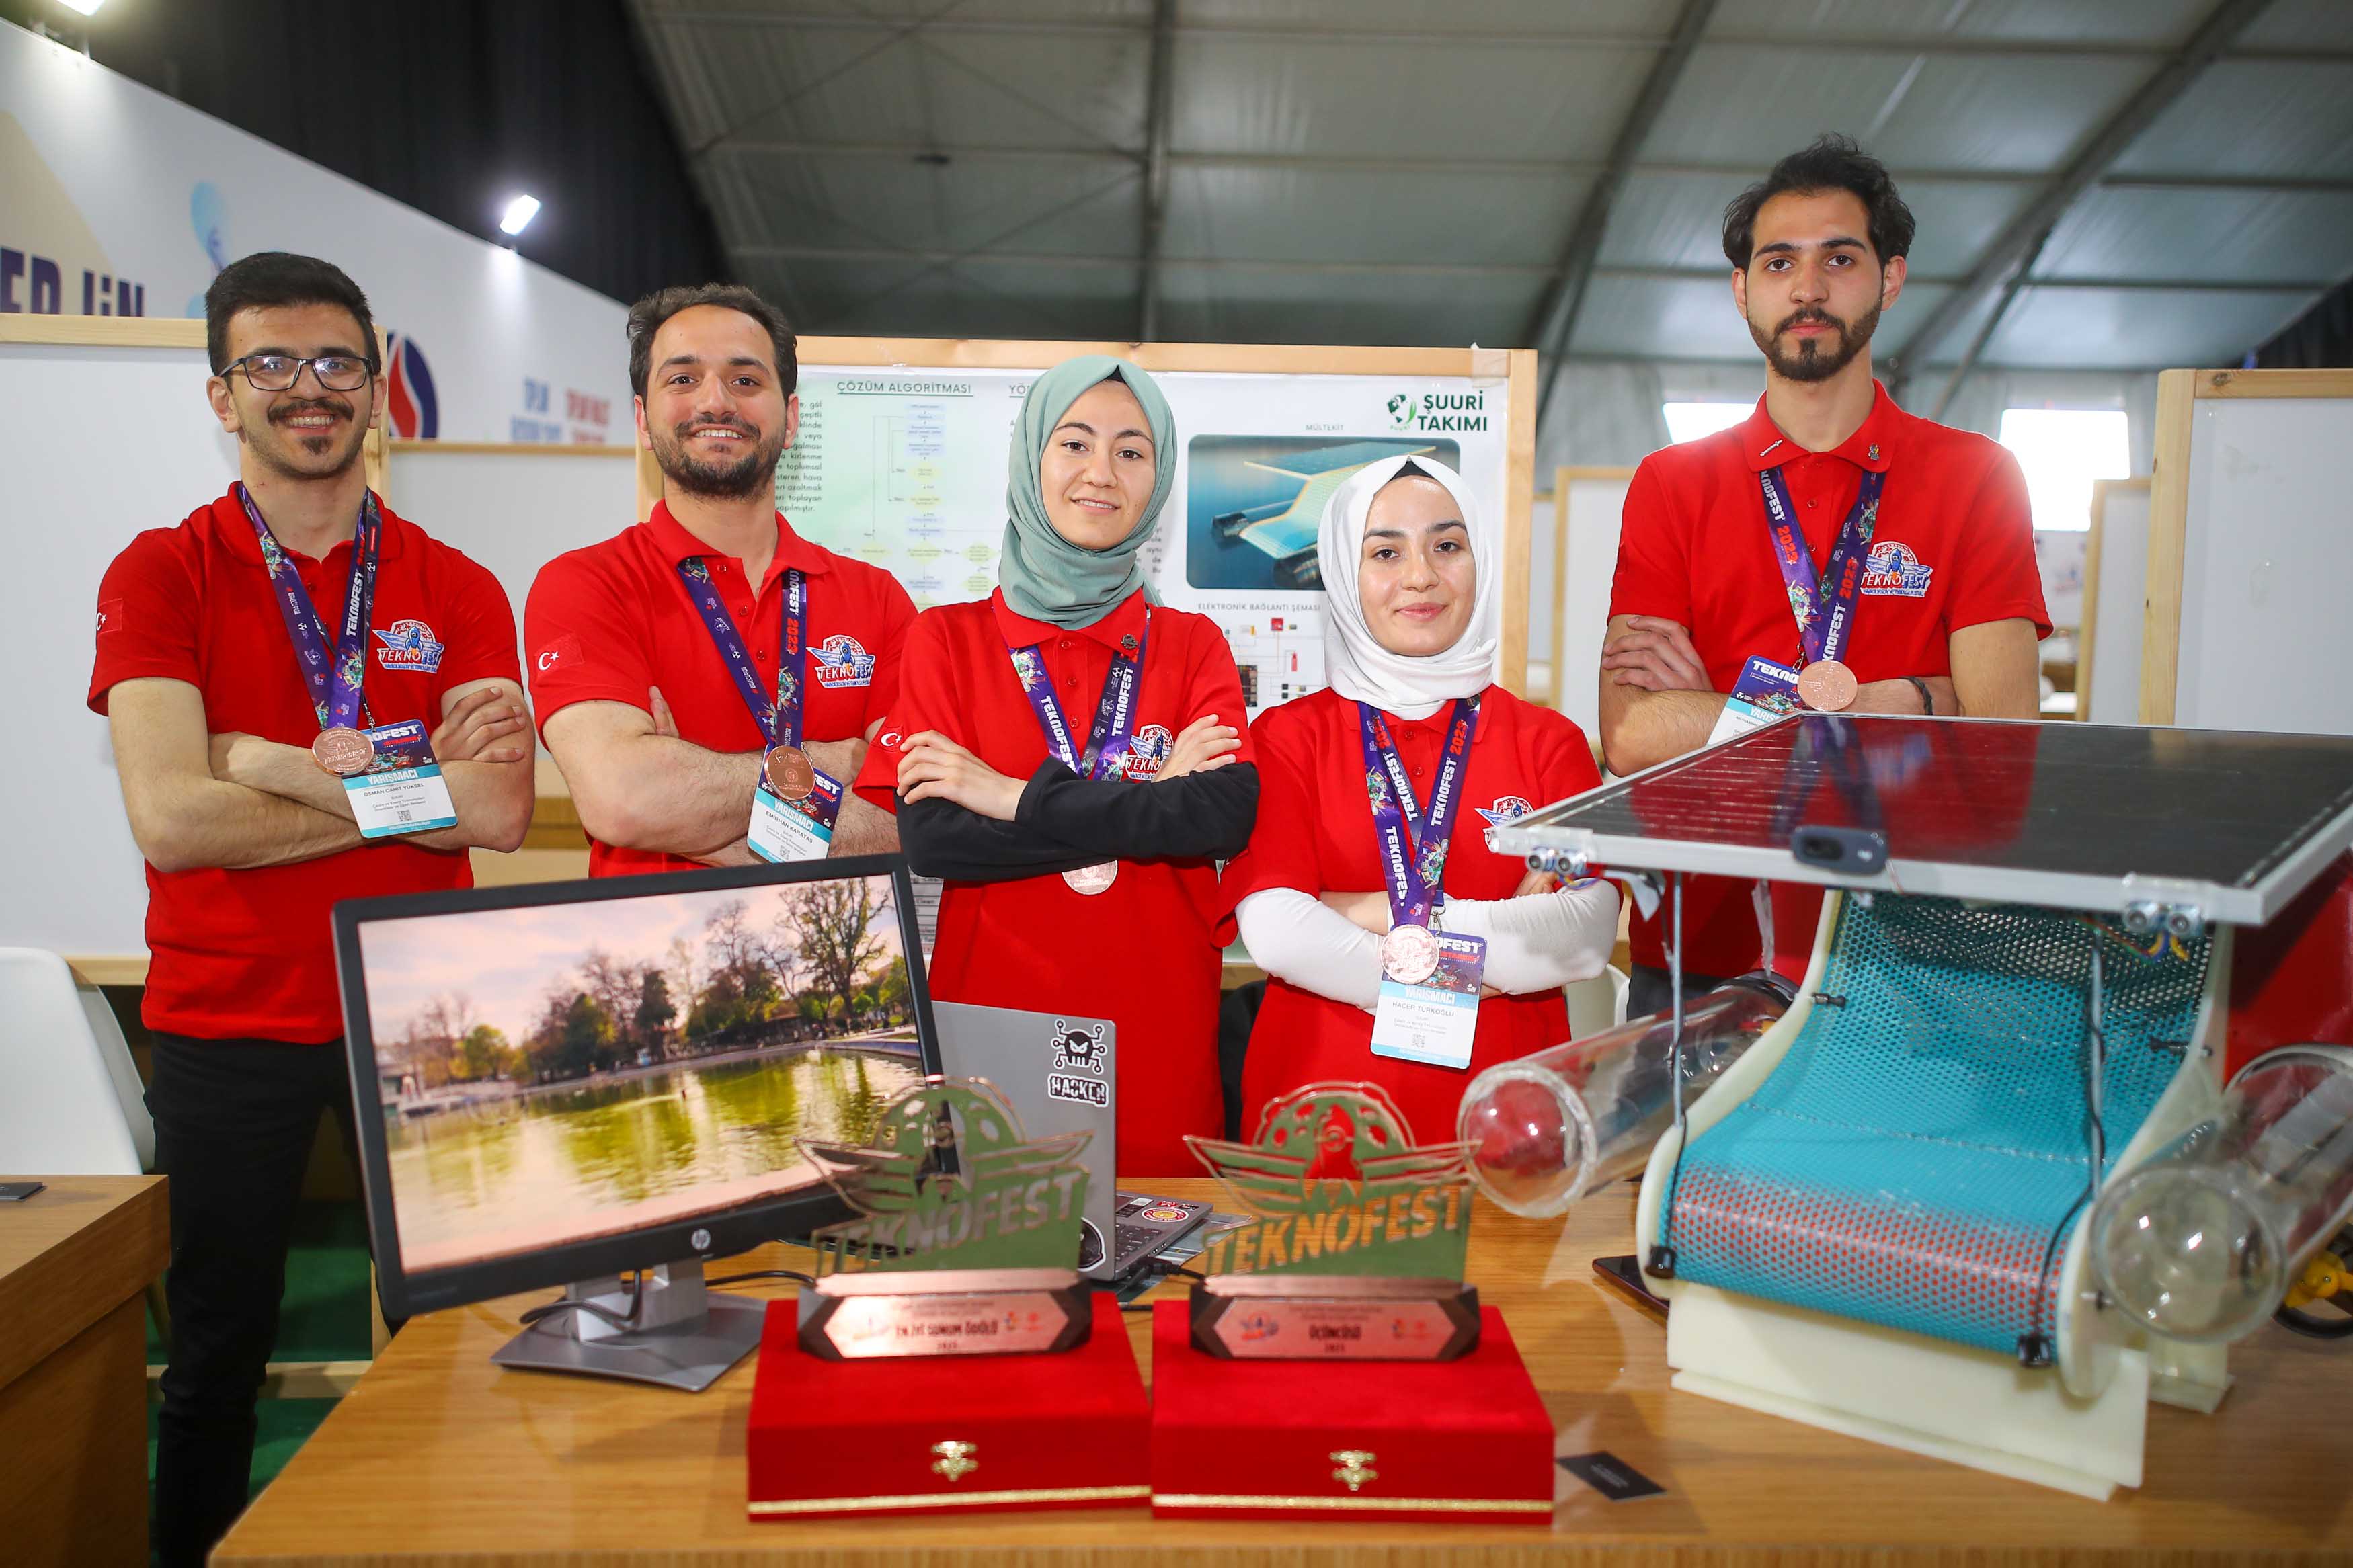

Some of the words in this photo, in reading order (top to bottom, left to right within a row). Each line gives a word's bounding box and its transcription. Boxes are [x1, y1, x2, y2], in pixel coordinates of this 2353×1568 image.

[837, 381, 883, 393] ÇÖZÜM
[889, 382, 971, 393] ALGORİTMASI
[1423, 390, 1484, 414] ŞUURİ
[1417, 415, 1488, 431] TAKIMI
[786, 462, 822, 471] toplumsal
[787, 483, 822, 491] azaltmak
[1761, 470, 1785, 520] KNOFEST
[1777, 525, 1798, 563] 2023
[1861, 574, 1927, 588] TEKNOFEST
[789, 570, 799, 615] NOFEST
[346, 569, 364, 637] TEKNOFEST
[1198, 602, 1248, 610] ELEKTRONİK
[1822, 602, 1845, 661] KNOFEST
[1839, 557, 1858, 599] 2023
[787, 618, 799, 655] 2023
[381, 650, 441, 665] TEKNOFEST
[818, 664, 873, 679] TEKNOFEST
[1753, 660, 1799, 684] TEKNO
[1111, 666, 1133, 736] TEKNOFEST
[370, 725, 420, 741] OFEST
[1127, 758, 1160, 771] TEKNO
[1431, 757, 1457, 826] TEKNOFEST
[1450, 719, 1468, 755] 2023
[364, 788, 385, 796] OSMAN
[1383, 752, 1418, 822] TEKNOFEST
[1386, 826, 1408, 907] TEKNOFES
[1436, 937, 1483, 954] OFEST
[1392, 1001, 1416, 1012] HACER
[1050, 1075, 1107, 1104] HACKER
[1207, 1183, 1462, 1276] TEKNOFEST
